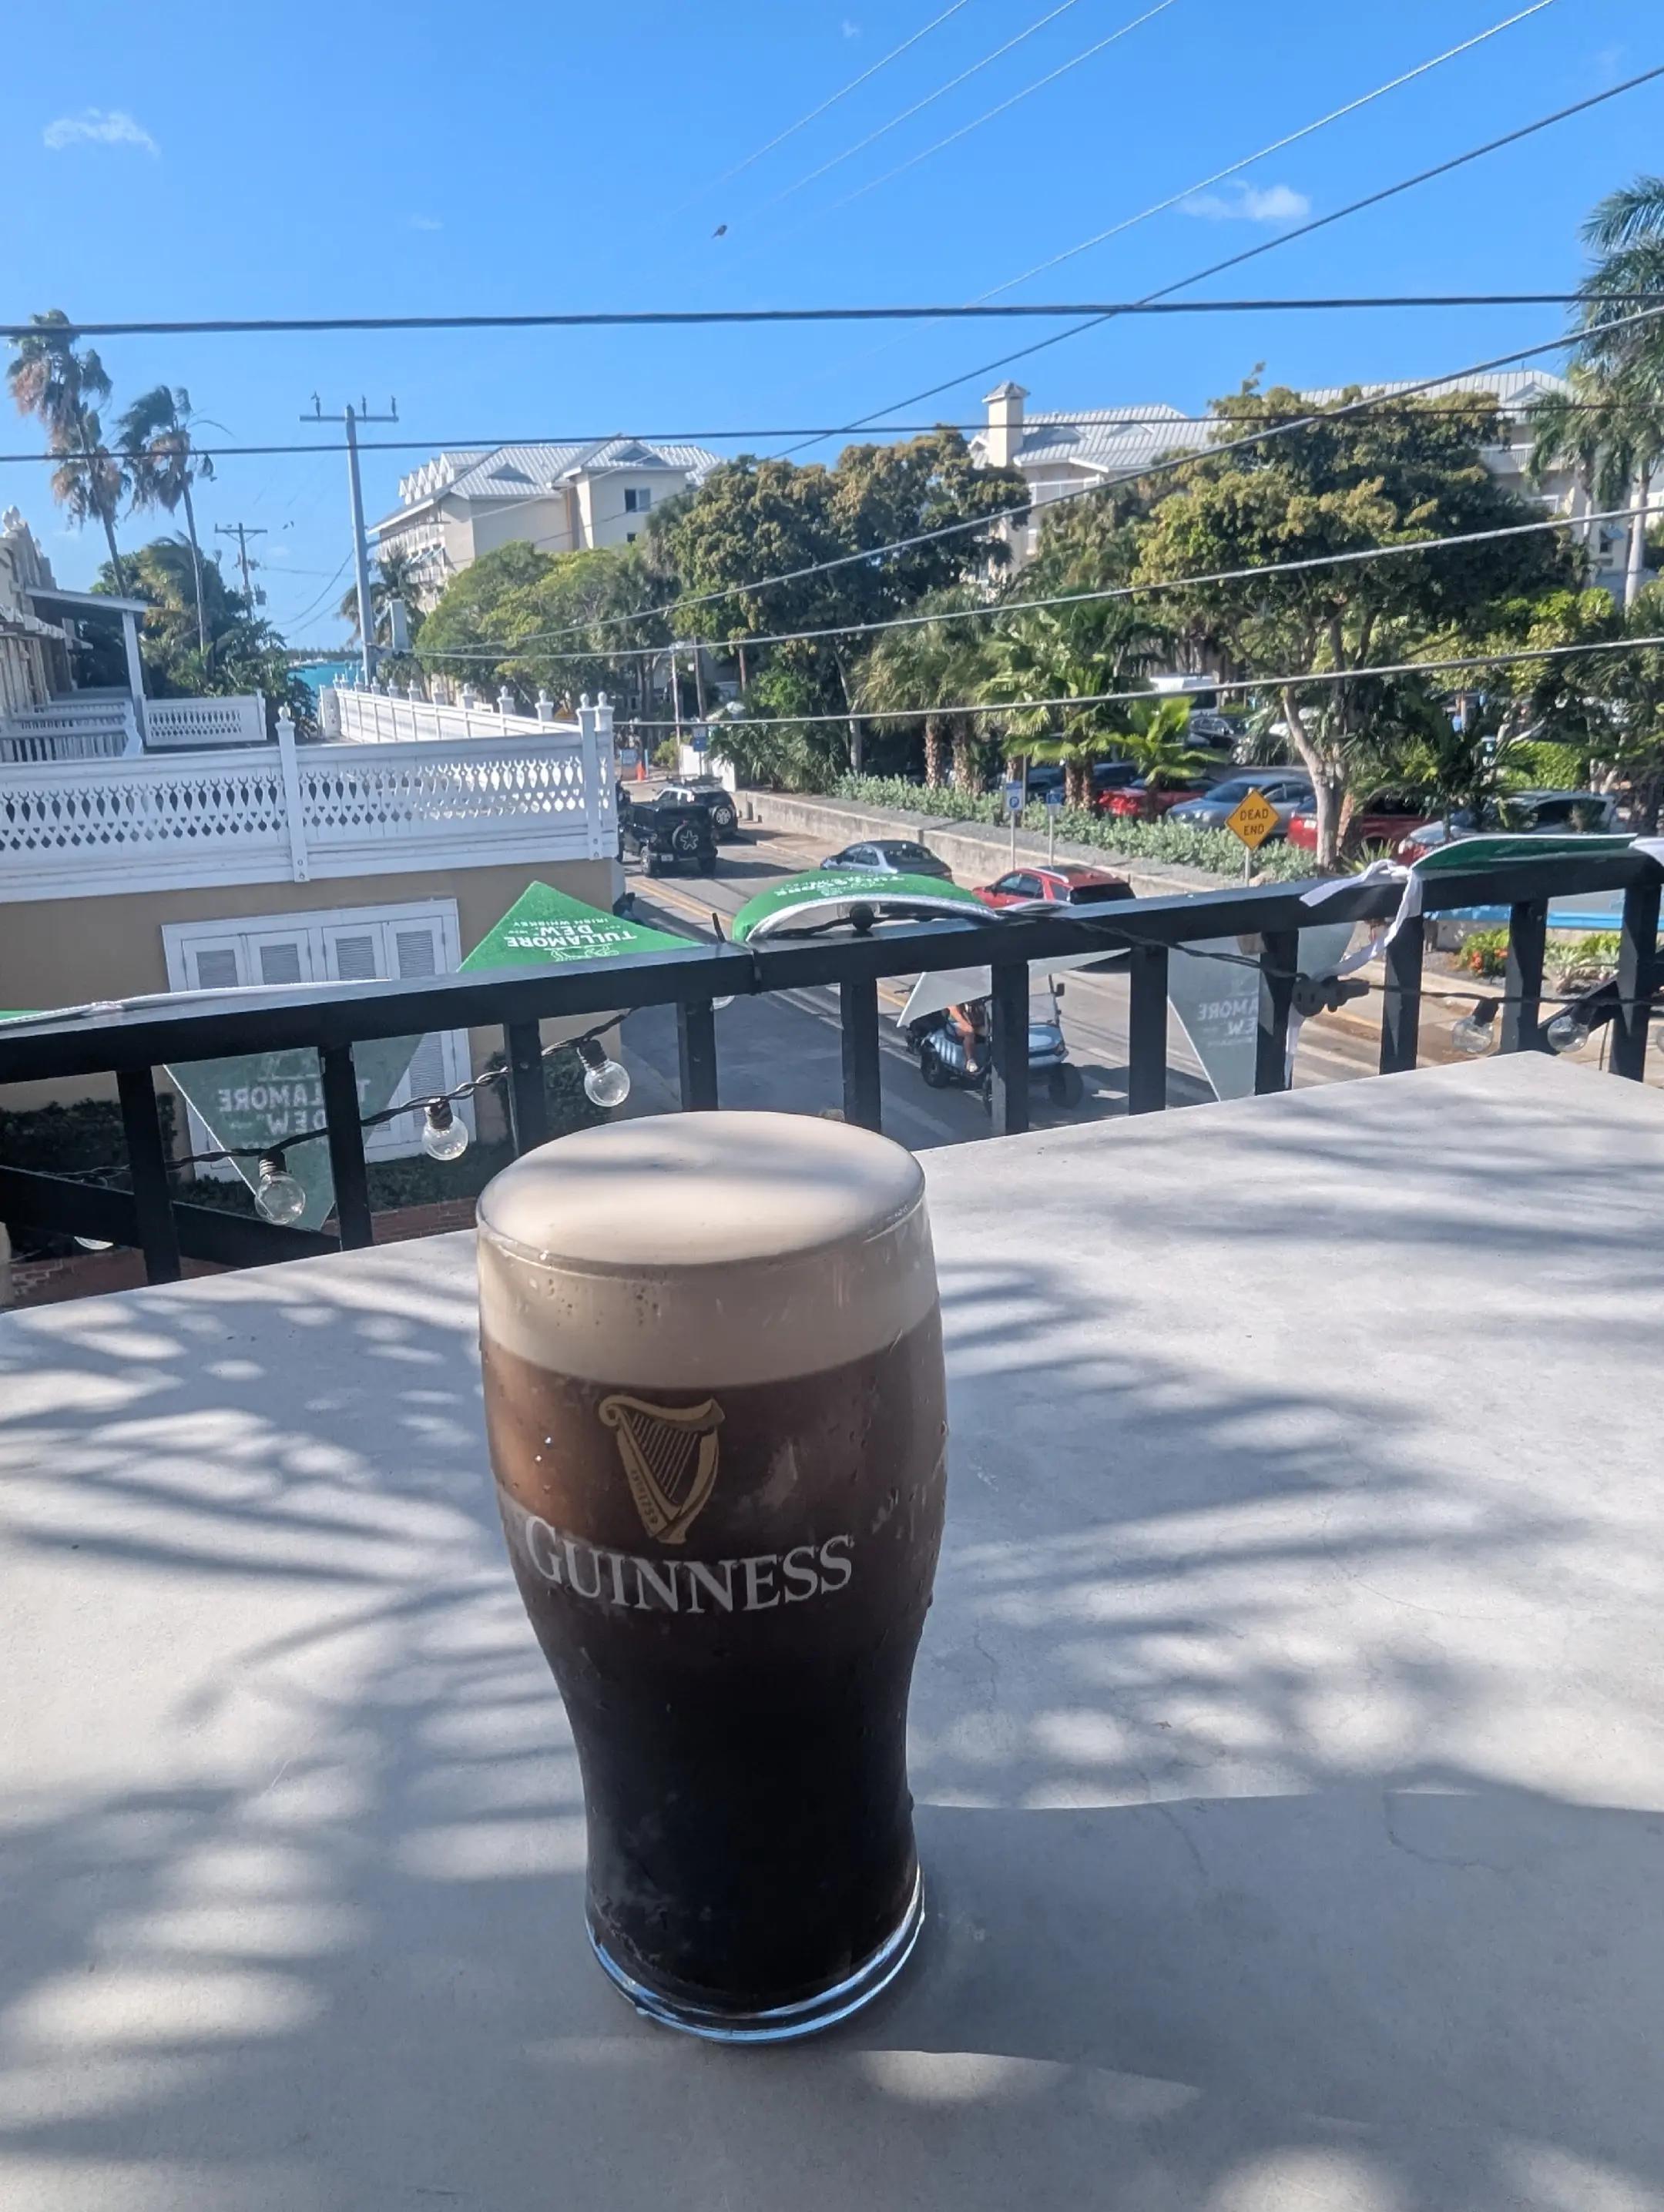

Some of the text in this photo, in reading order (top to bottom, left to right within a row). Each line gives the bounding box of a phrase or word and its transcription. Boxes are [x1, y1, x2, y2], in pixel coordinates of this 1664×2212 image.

[1240, 809, 1269, 821] DEAD
[1243, 823, 1264, 836] END
[504, 930, 637, 947] TULLAMORE
[525, 1516, 853, 1613] GUINNESS
